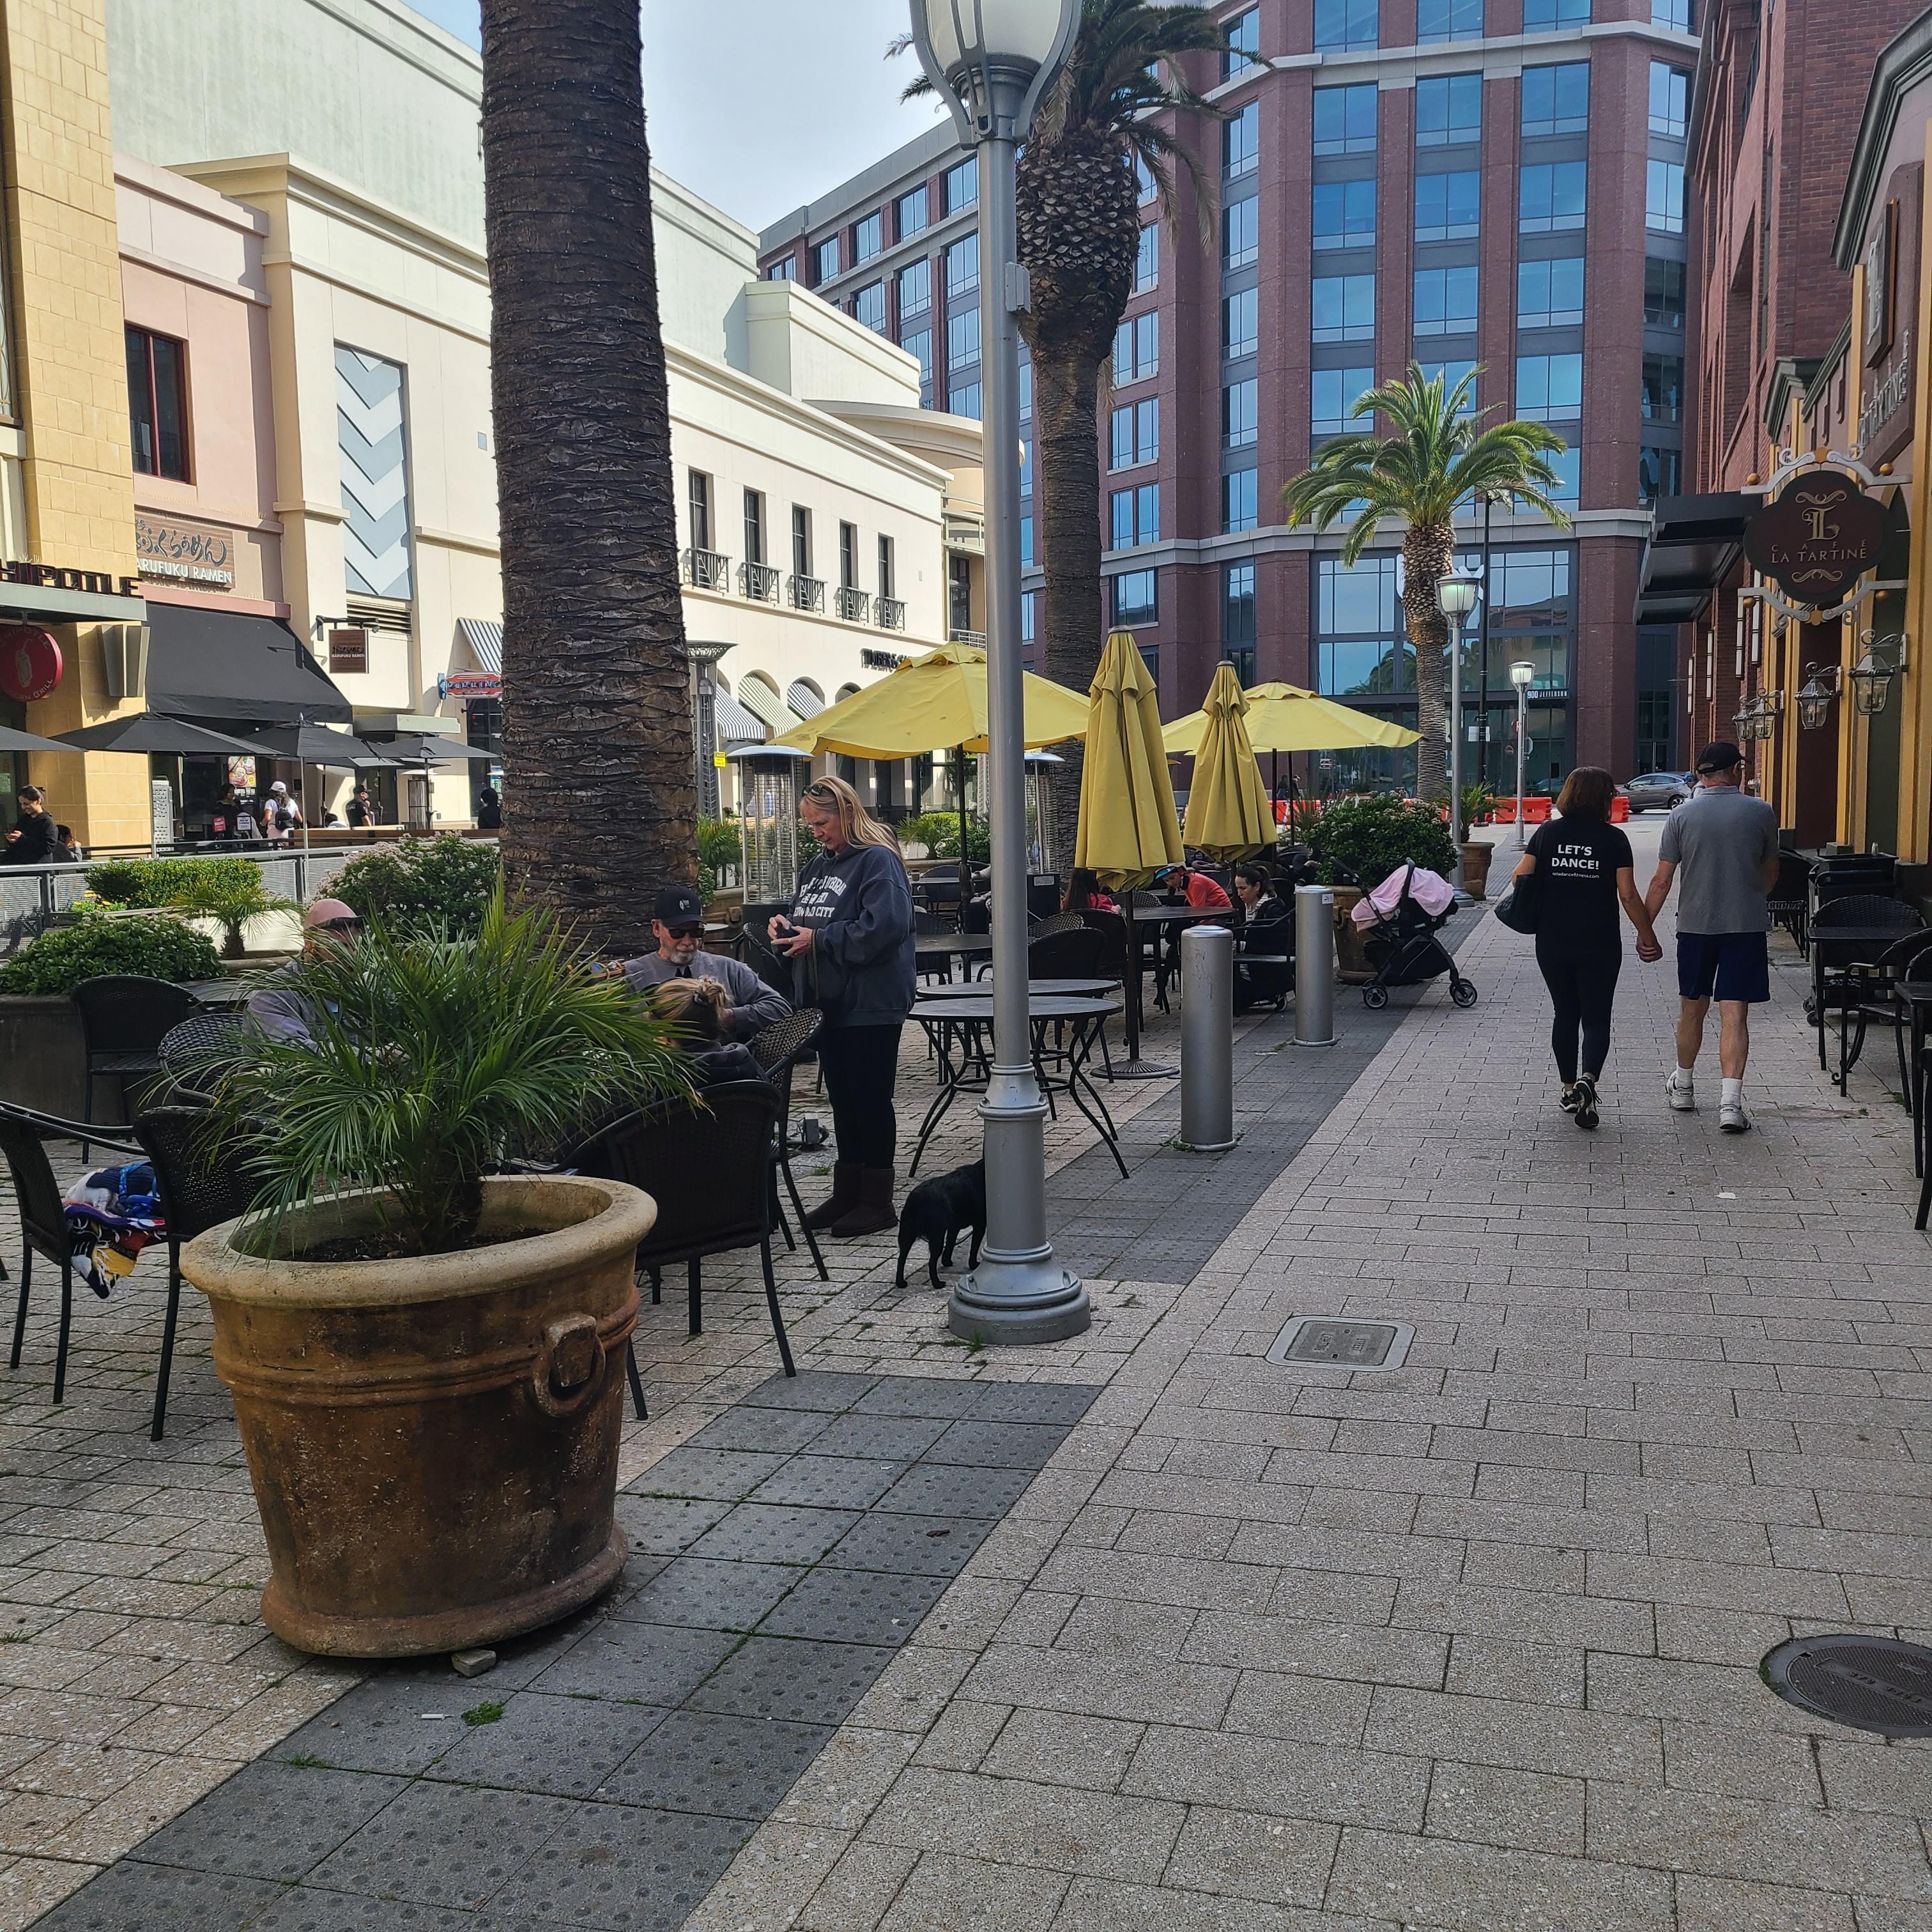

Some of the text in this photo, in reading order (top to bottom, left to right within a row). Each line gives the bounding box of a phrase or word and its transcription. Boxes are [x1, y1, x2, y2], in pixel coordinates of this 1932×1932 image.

[1772, 548, 1866, 564] LA TARTINE
[193, 566, 233, 584] RAMEN
[33, 678, 53, 698] GRILL
[1527, 690, 1538, 699] 900
[1558, 844, 1592, 856] LET'S
[1551, 857, 1599, 870] DANCE!
[815, 906, 835, 918] CITY
